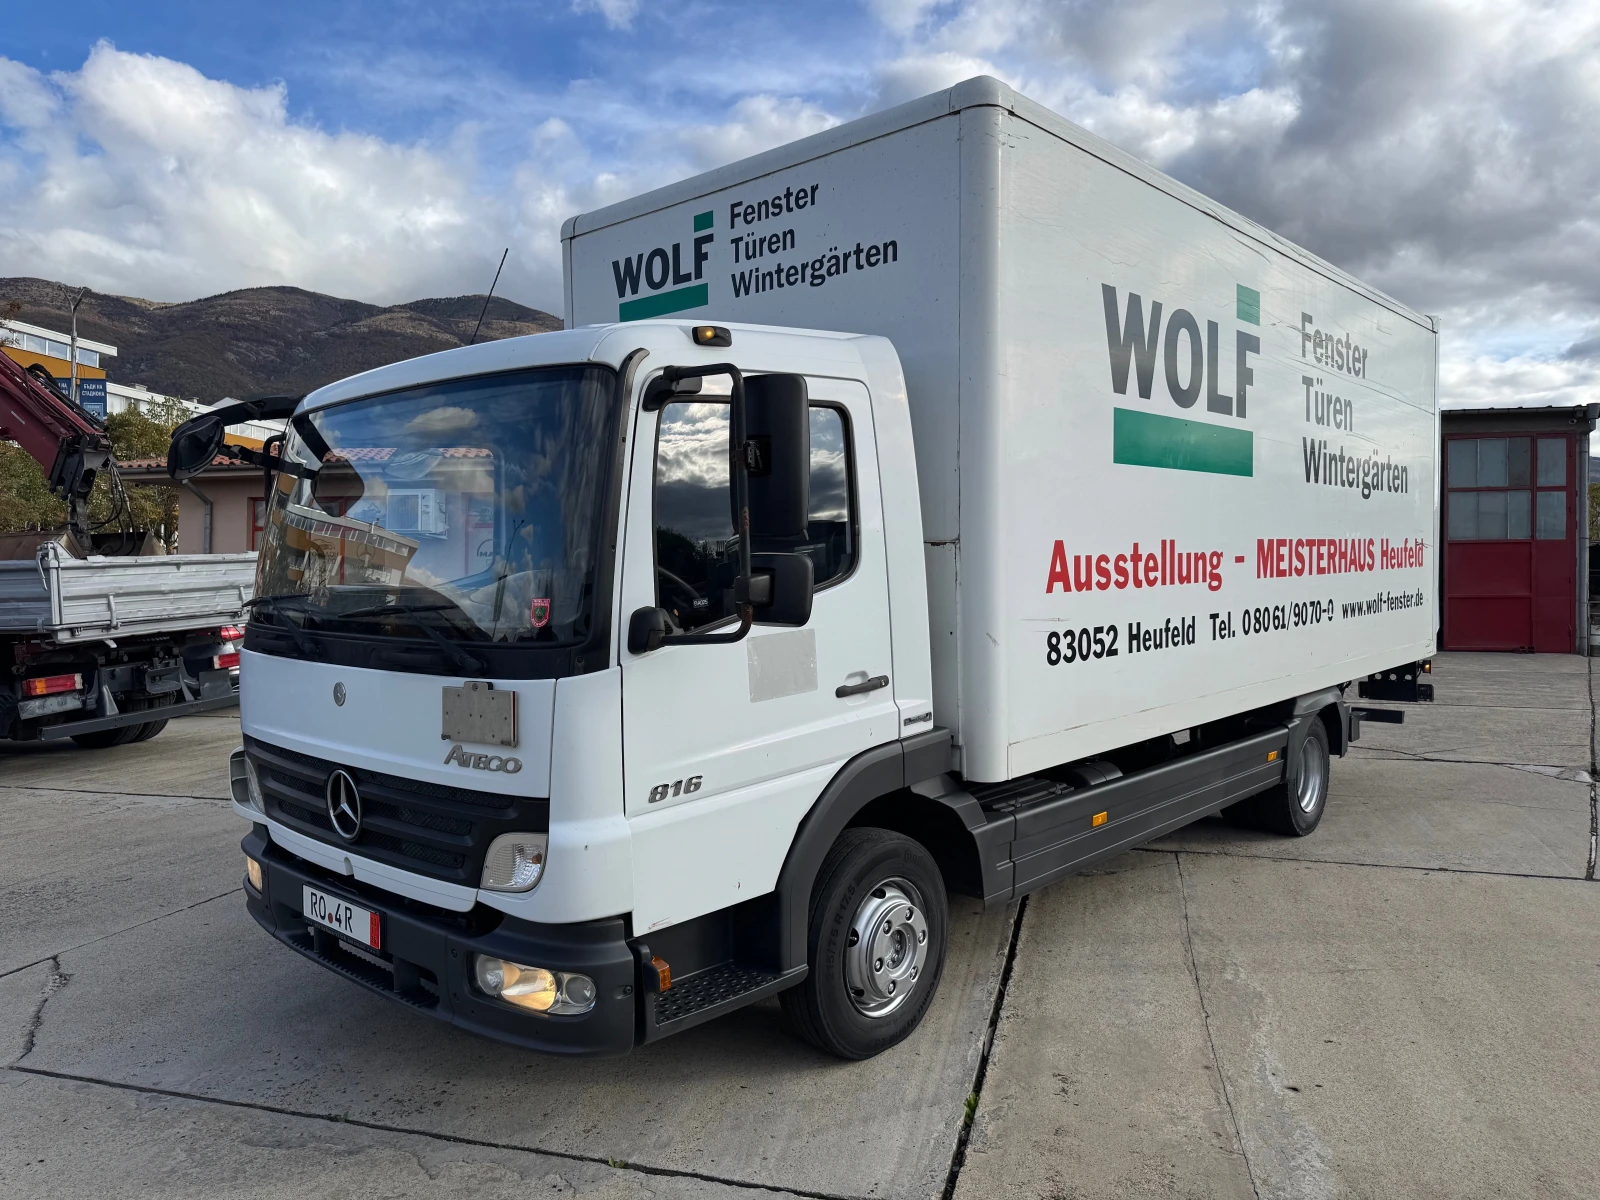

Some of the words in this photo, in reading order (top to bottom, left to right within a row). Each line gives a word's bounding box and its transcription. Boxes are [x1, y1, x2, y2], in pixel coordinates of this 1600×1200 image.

[730, 183, 819, 230] Fenster
[612, 233, 714, 299] WOLF
[731, 228, 795, 264] Türen
[731, 239, 898, 298] Wintergärten
[1101, 282, 1261, 419] WOLF
[1301, 311, 1368, 380] Fenster
[1302, 375, 1353, 432] Türen
[1302, 436, 1409, 500] Wintergärten
[1045, 539, 1224, 593] Ausstellung
[1234, 555, 1245, 563] -
[1256, 537, 1375, 579] MEISTERHAUS
[1380, 537, 1424, 570] Heufeld
[1046, 625, 1119, 666] 83052
[1128, 616, 1196, 654] Heufeld
[1209, 611, 1236, 641] Tel.
[1341, 587, 1424, 619] www.wolf-fenster.de
[647, 775, 703, 804] 816
[310, 891, 327, 920] RO
[334, 903, 353, 933] 4R
